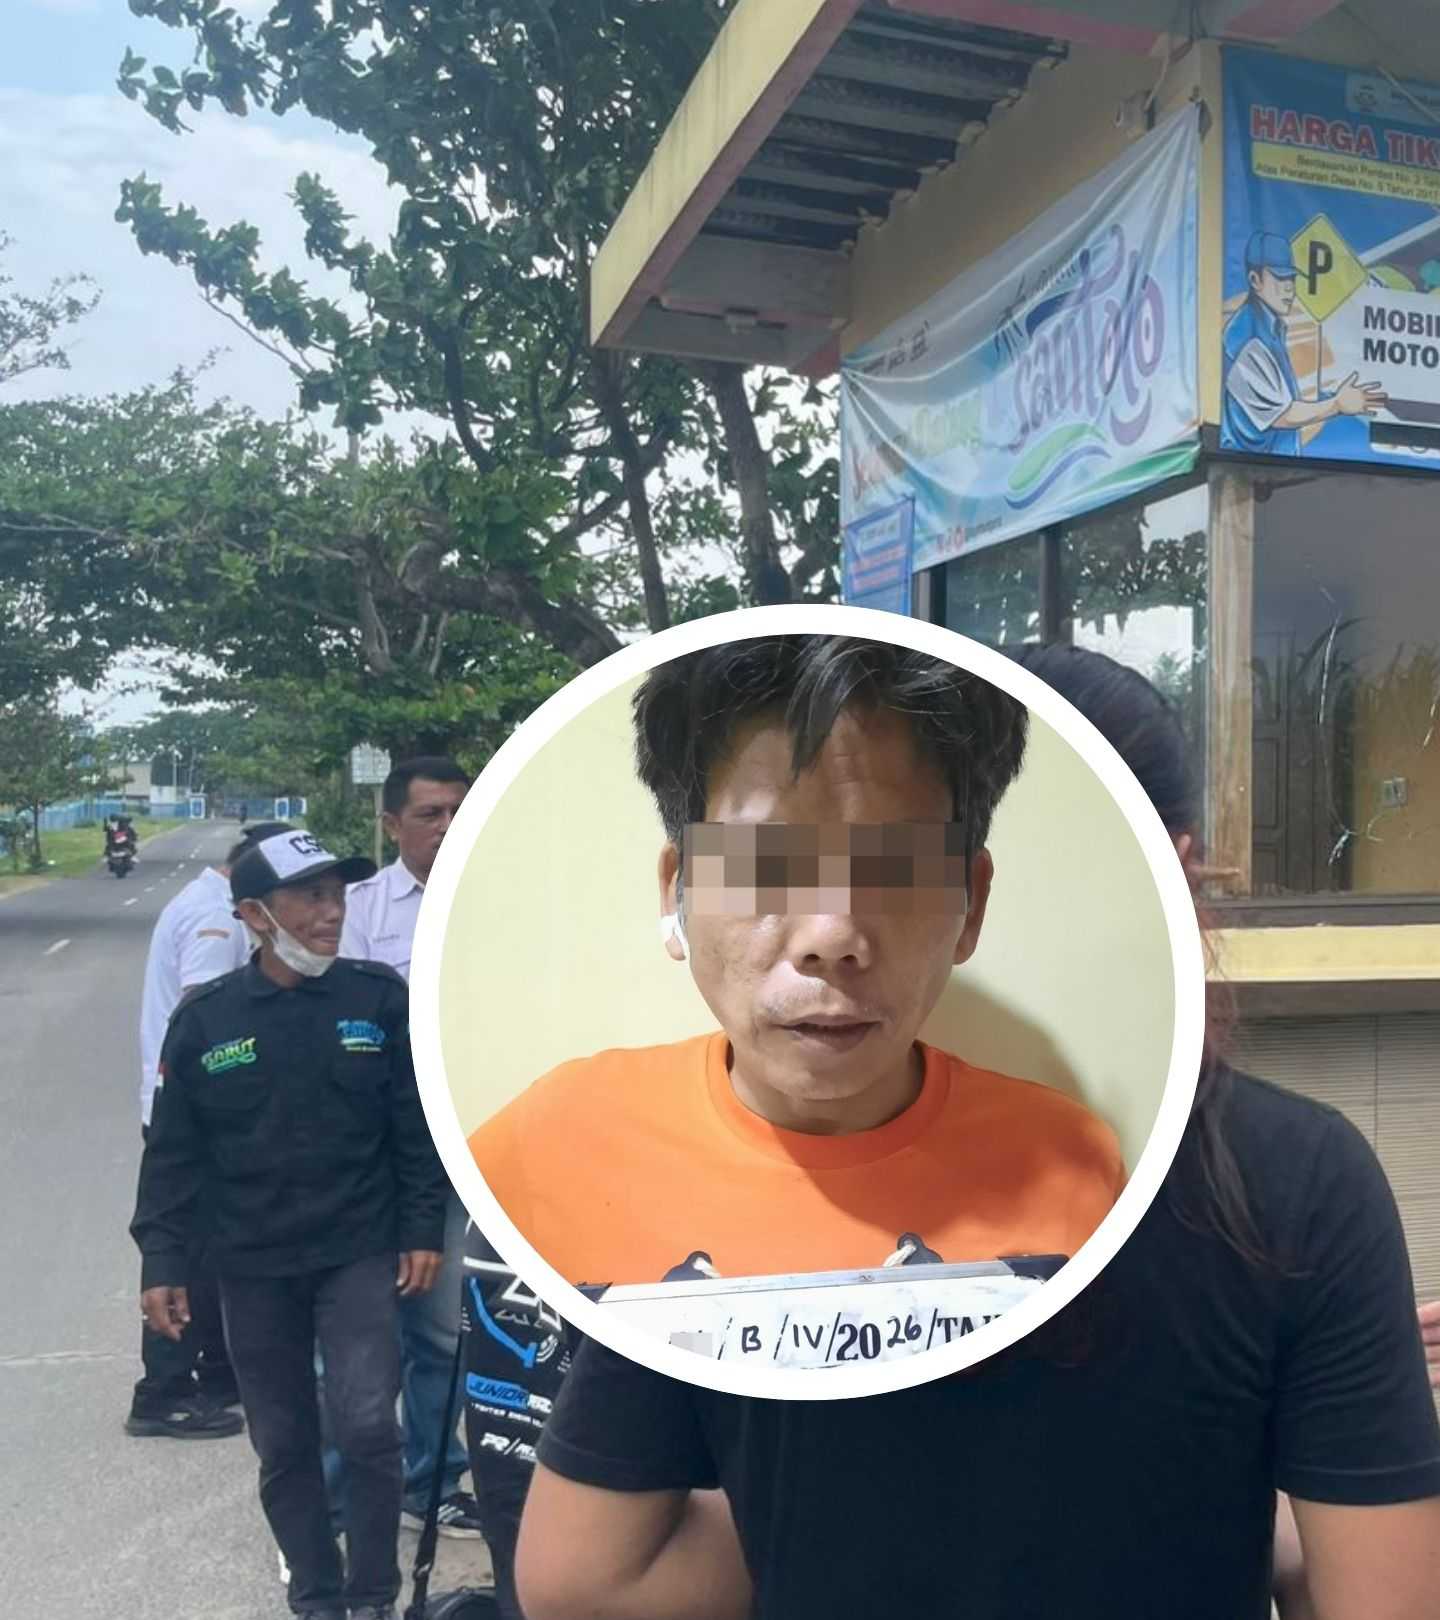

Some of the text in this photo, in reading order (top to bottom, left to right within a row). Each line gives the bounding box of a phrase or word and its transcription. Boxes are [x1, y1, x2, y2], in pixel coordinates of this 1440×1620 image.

[1251, 105, 1378, 159] HARGA
[1308, 240, 1333, 296] P
[201, 1037, 257, 1066] GARUT
